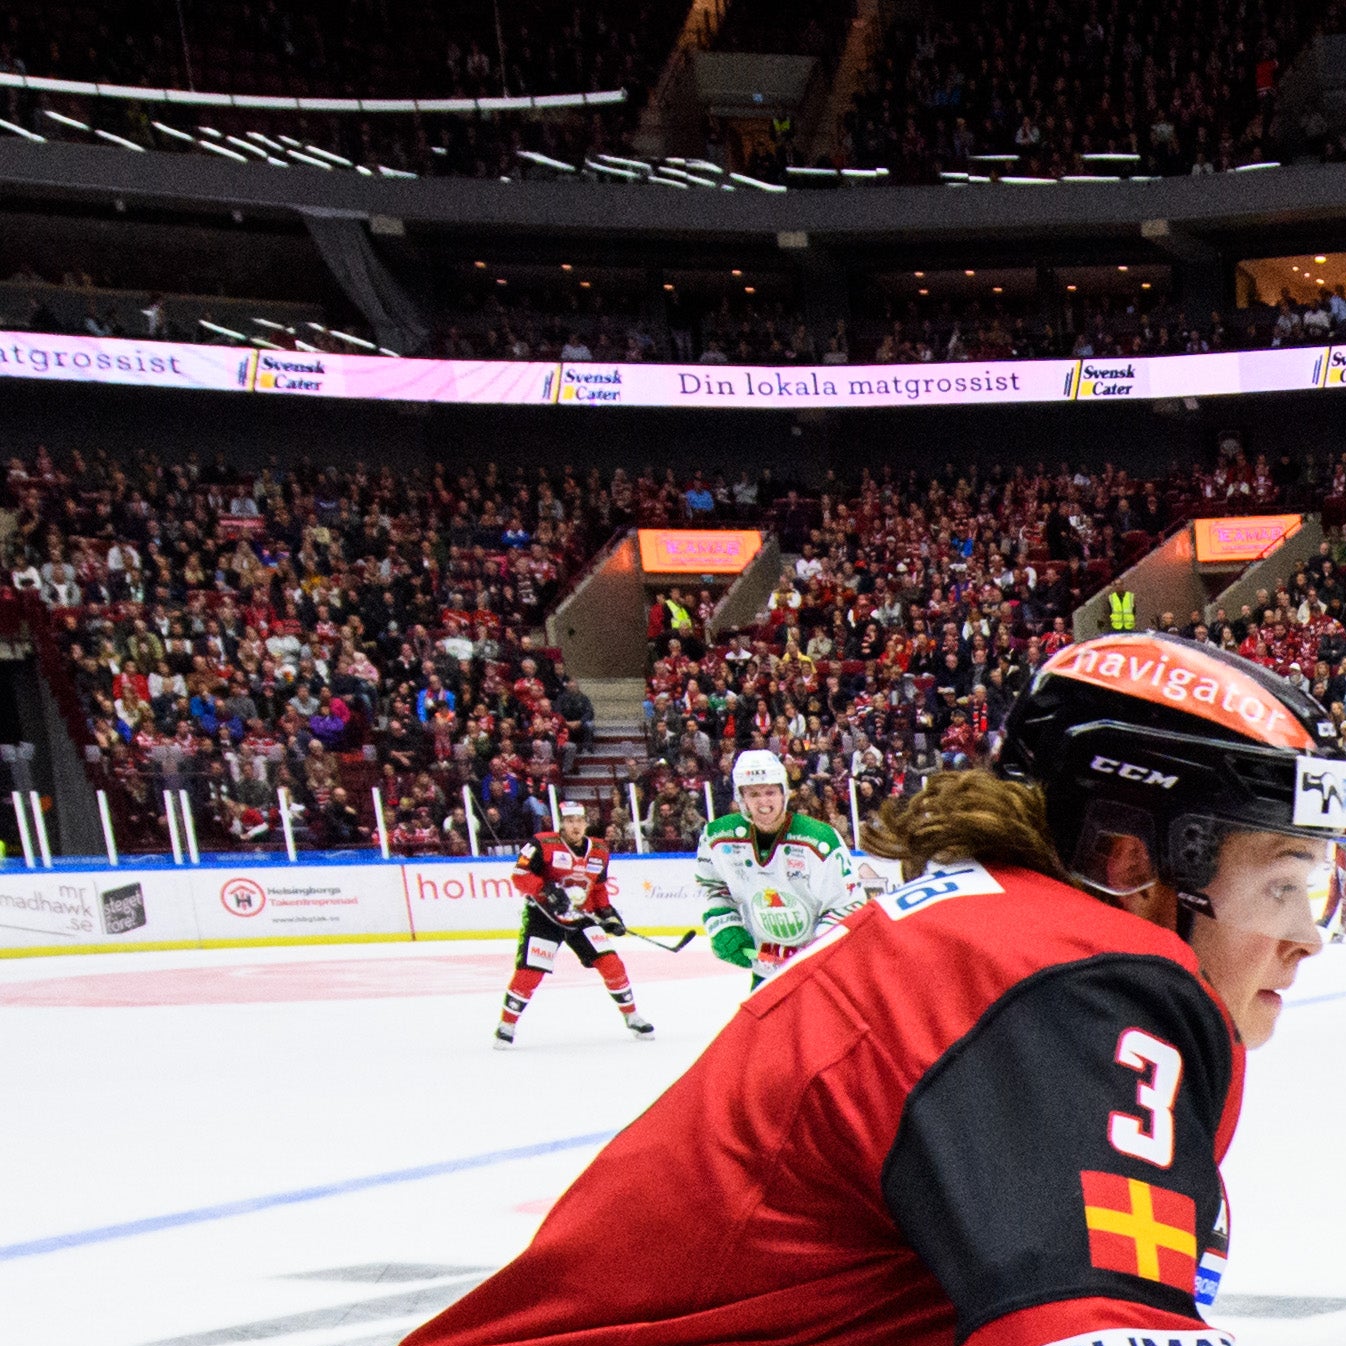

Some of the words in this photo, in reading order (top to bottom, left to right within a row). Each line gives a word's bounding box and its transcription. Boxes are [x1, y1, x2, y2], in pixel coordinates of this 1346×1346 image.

[263, 356, 325, 375] Svensk
[1083, 364, 1135, 381] Svensk
[274, 375, 322, 392] Cater
[564, 369, 622, 386] Svensk
[679, 373, 735, 397] Din
[746, 373, 837, 397] lokala
[849, 371, 1021, 400] matgrossist
[575, 386, 621, 402] Cater
[1092, 380, 1134, 396] Cater
[1071, 644, 1285, 732] navigator
[1091, 755, 1180, 790] CCM
[1107, 1026, 1184, 1170] 3
